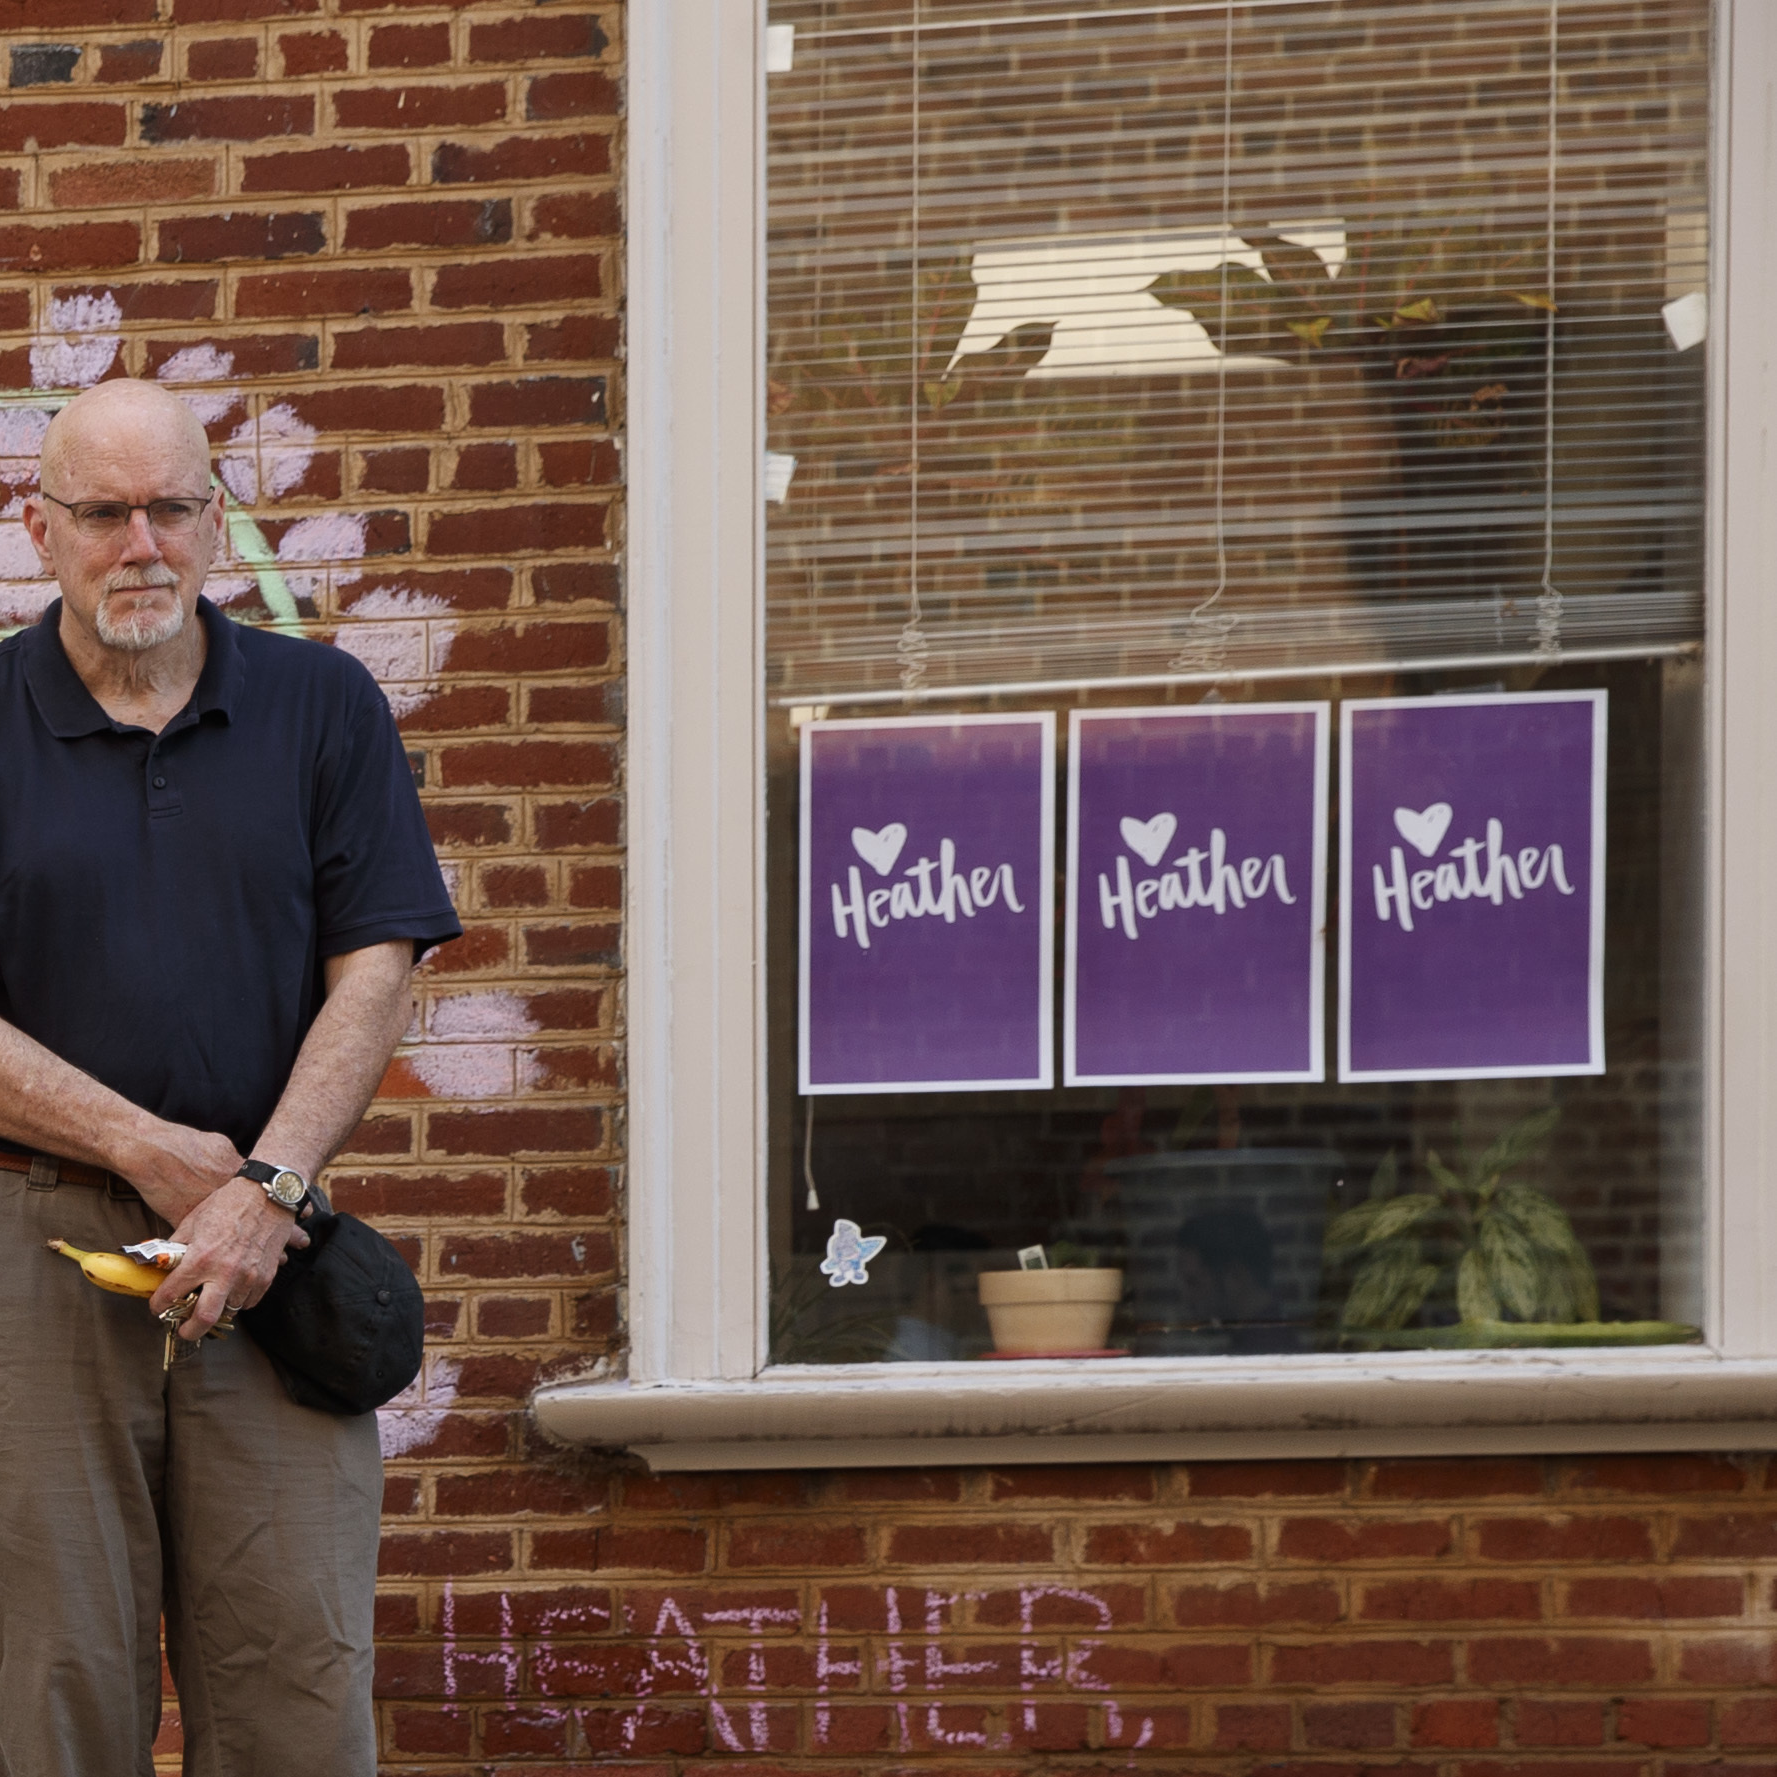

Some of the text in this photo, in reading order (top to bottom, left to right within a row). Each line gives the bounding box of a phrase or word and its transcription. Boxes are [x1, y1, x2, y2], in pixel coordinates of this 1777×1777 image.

[831, 837, 1026, 950] Heather
[1098, 827, 1298, 941] Heather
[1372, 817, 1576, 932] Heather
[441, 1574, 1155, 1756] HEATHER
